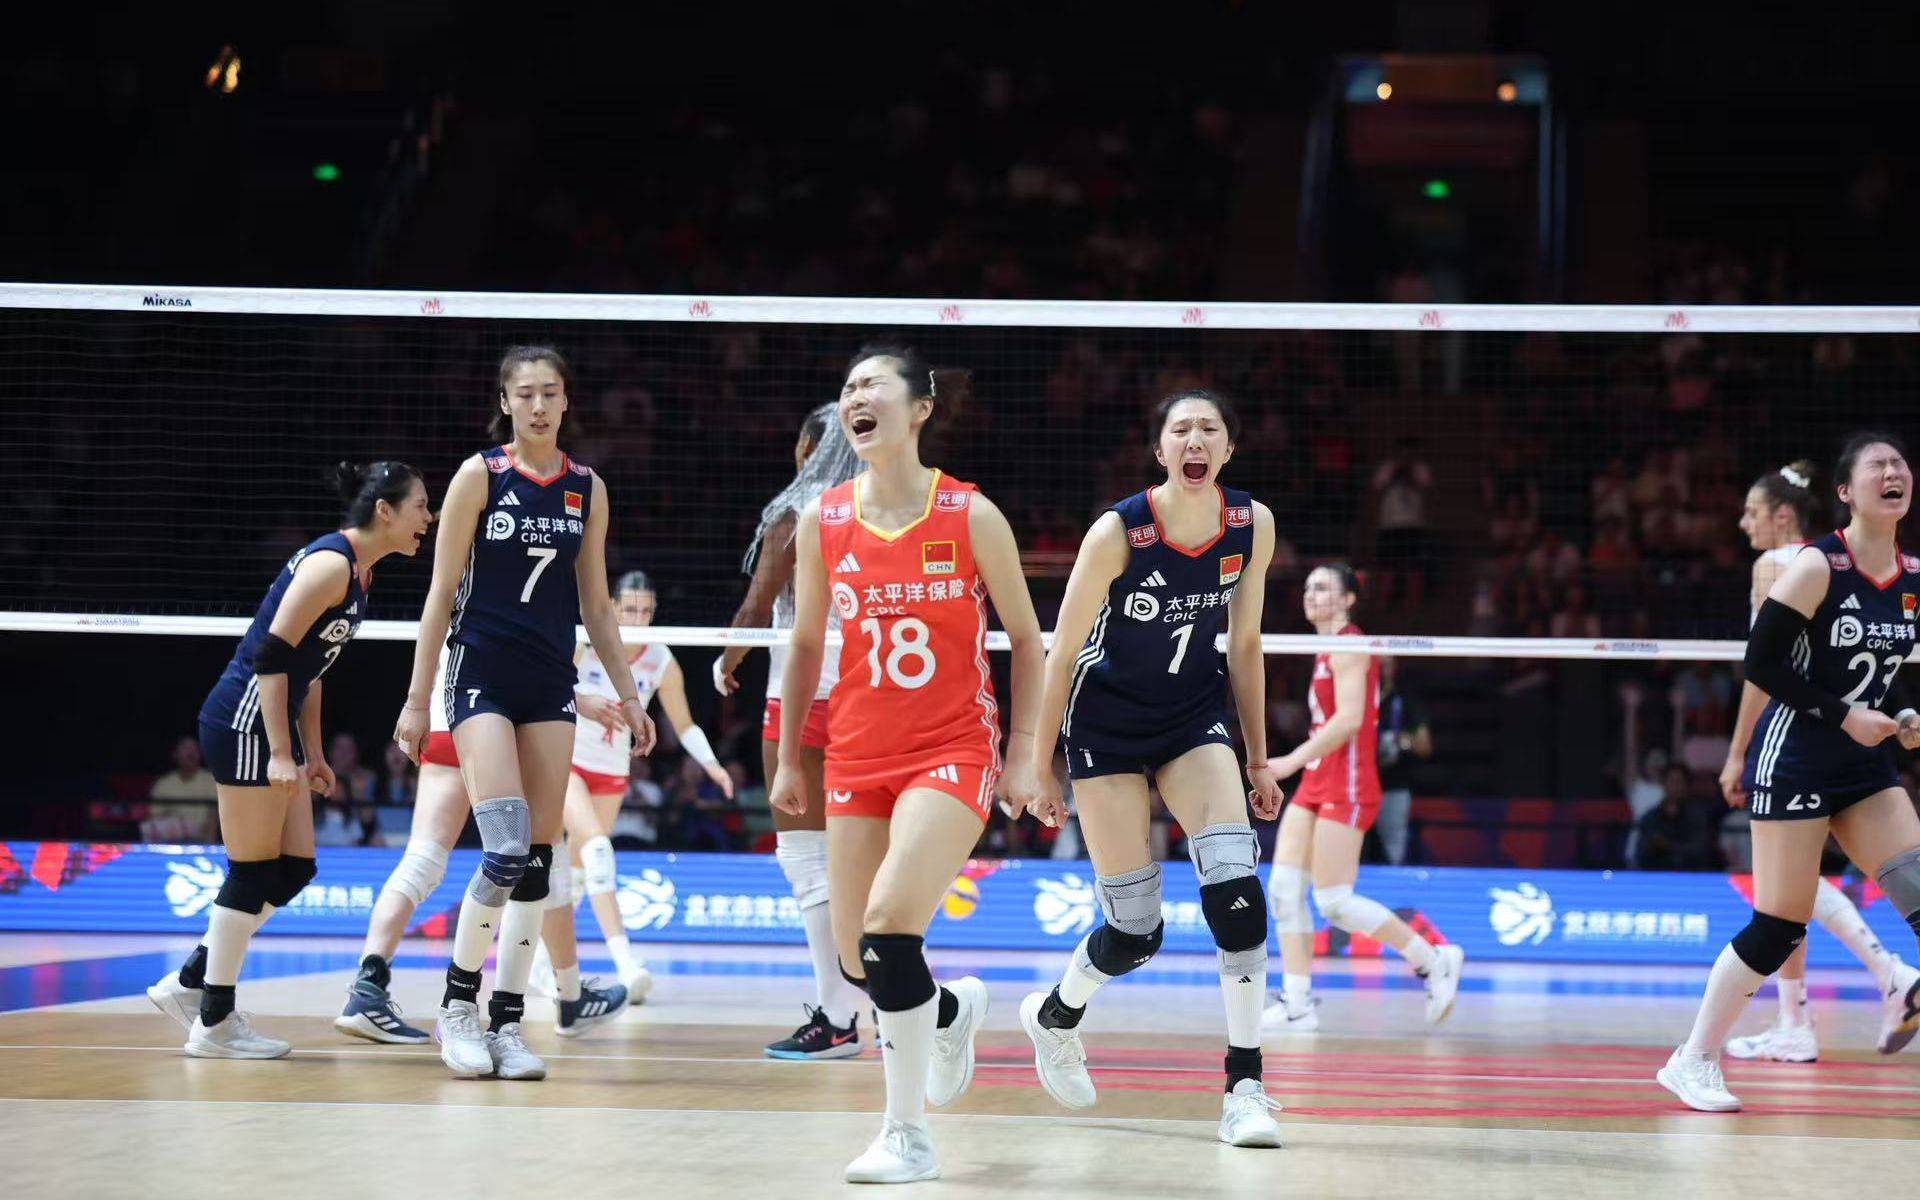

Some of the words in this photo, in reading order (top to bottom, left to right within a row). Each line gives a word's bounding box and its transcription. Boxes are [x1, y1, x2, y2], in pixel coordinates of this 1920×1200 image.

[936, 492, 966, 506] 光明
[822, 504, 851, 519] 光明
[1227, 509, 1250, 521] 光明
[521, 532, 552, 544] CPIC
[1130, 525, 1156, 543] 光明
[520, 547, 557, 603] 7
[928, 563, 952, 572] CHN
[1223, 573, 1238, 583] CHN
[863, 578, 965, 604] 太平洋保险
[1165, 586, 1237, 612] 太平洋保
[866, 606, 907, 617] CPIC
[1163, 611, 1198, 623] CPIC
[1167, 624, 1194, 674] 1
[1866, 638, 1894, 650] CPIC
[860, 617, 936, 689] 18
[1840, 652, 1904, 709] 23
[466, 688, 482, 709] 7
